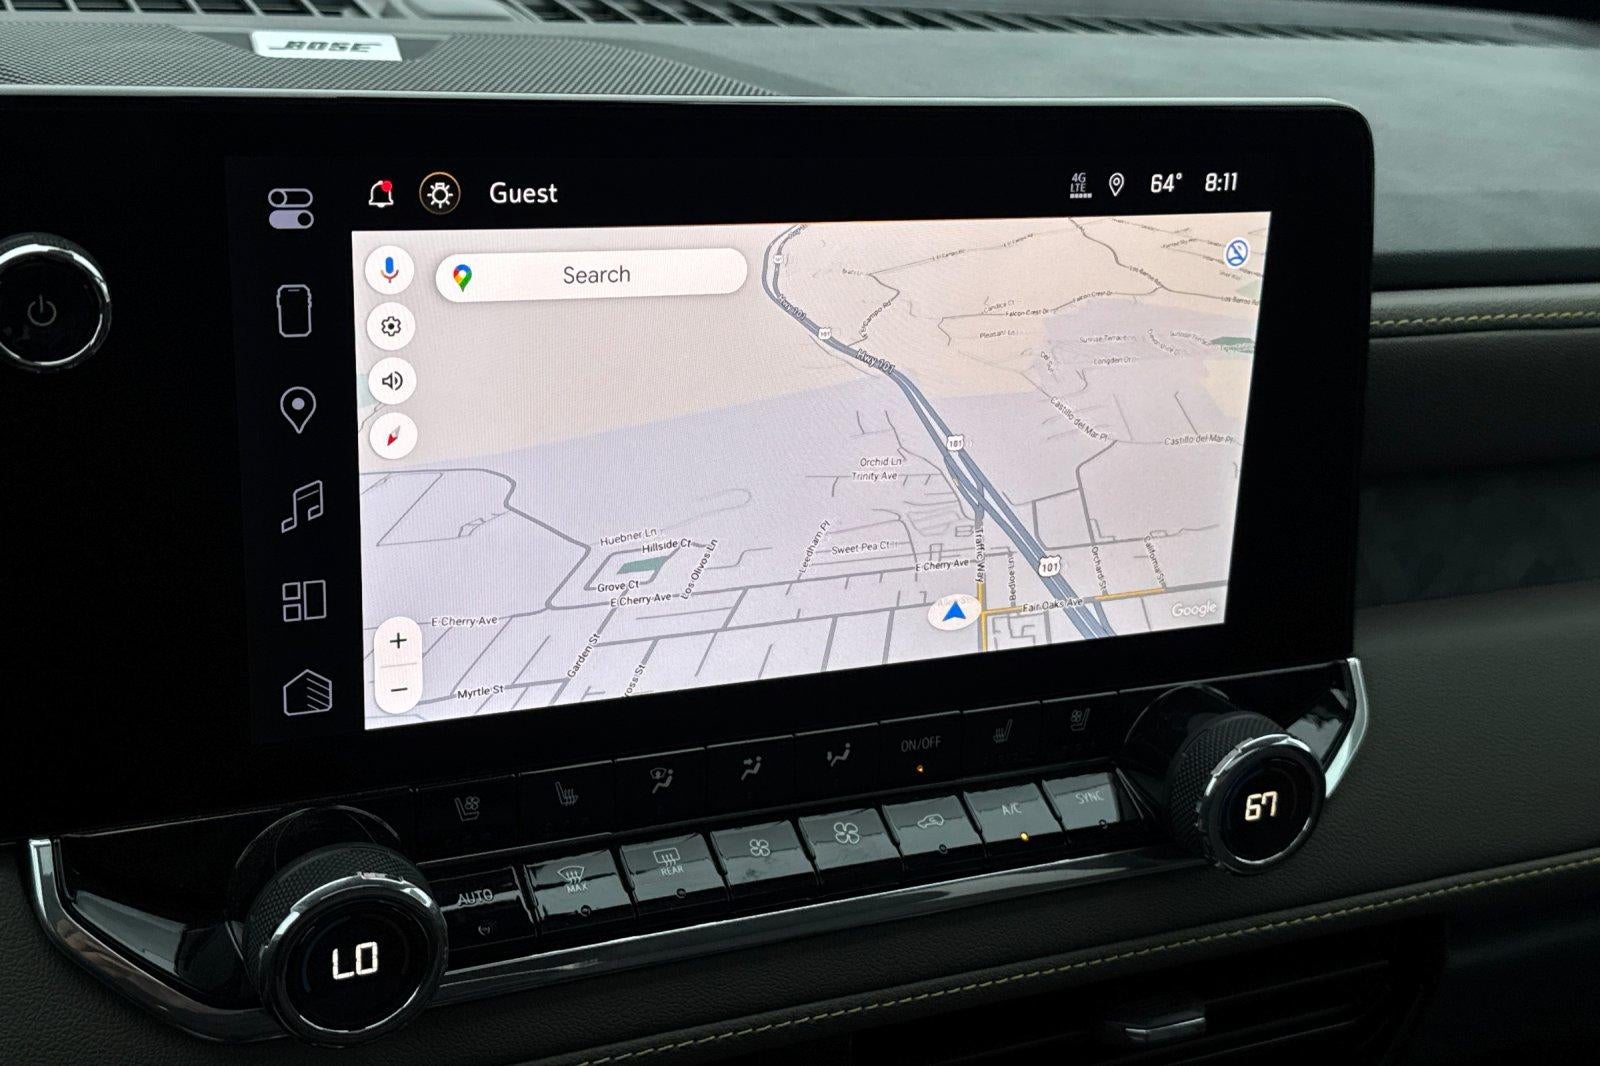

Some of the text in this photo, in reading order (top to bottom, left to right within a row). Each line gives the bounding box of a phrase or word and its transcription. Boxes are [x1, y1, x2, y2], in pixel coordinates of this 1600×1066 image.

[268, 41, 382, 52] BOSE
[1071, 172, 1087, 183] 4G
[1204, 172, 1238, 192] 8:11
[489, 181, 559, 204] Guest
[1070, 183, 1087, 193] LTE
[562, 264, 631, 284] Search
[856, 348, 896, 375] Hwy 101
[1050, 397, 1074, 421] Castillo
[1073, 418, 1087, 432] del
[1084, 426, 1100, 439] Mar
[1164, 435, 1194, 446] Castillo
[860, 457, 902, 467] Orchid Ln
[852, 472, 898, 482] Trinity Ave
[600, 528, 657, 546] Huebner Ln
[641, 538, 692, 554] Hillside Ct
[799, 519, 831, 574] Leedham Pl
[831, 541, 890, 555] Sweet Pea Ct
[975, 527, 986, 583] Traffic Way
[681, 538, 718, 600] Los Olivos Ln
[923, 561, 952, 572] Cherry
[953, 558, 969, 567] Ave
[1041, 563, 1058, 573] 101
[1092, 546, 1104, 580] Orchard
[597, 580, 639, 592] Grove Ct
[610, 592, 672, 607] E Cherry Ave
[1022, 598, 1083, 613] Fair Oaks Ave
[1171, 602, 1217, 618] Google
[431, 615, 498, 628] E Cherry Ave
[567, 632, 601, 679] Garden St
[634, 664, 645, 675] St
[457, 684, 504, 700] Myrtle St
[901, 735, 942, 752] ON/OFF
[1075, 791, 1104, 804] SYNC
[1002, 804, 1022, 816] A/C
[1245, 790, 1278, 821] 67
[660, 865, 685, 876] REAR
[565, 882, 588, 894] MAX
[458, 889, 493, 905] AUTO
